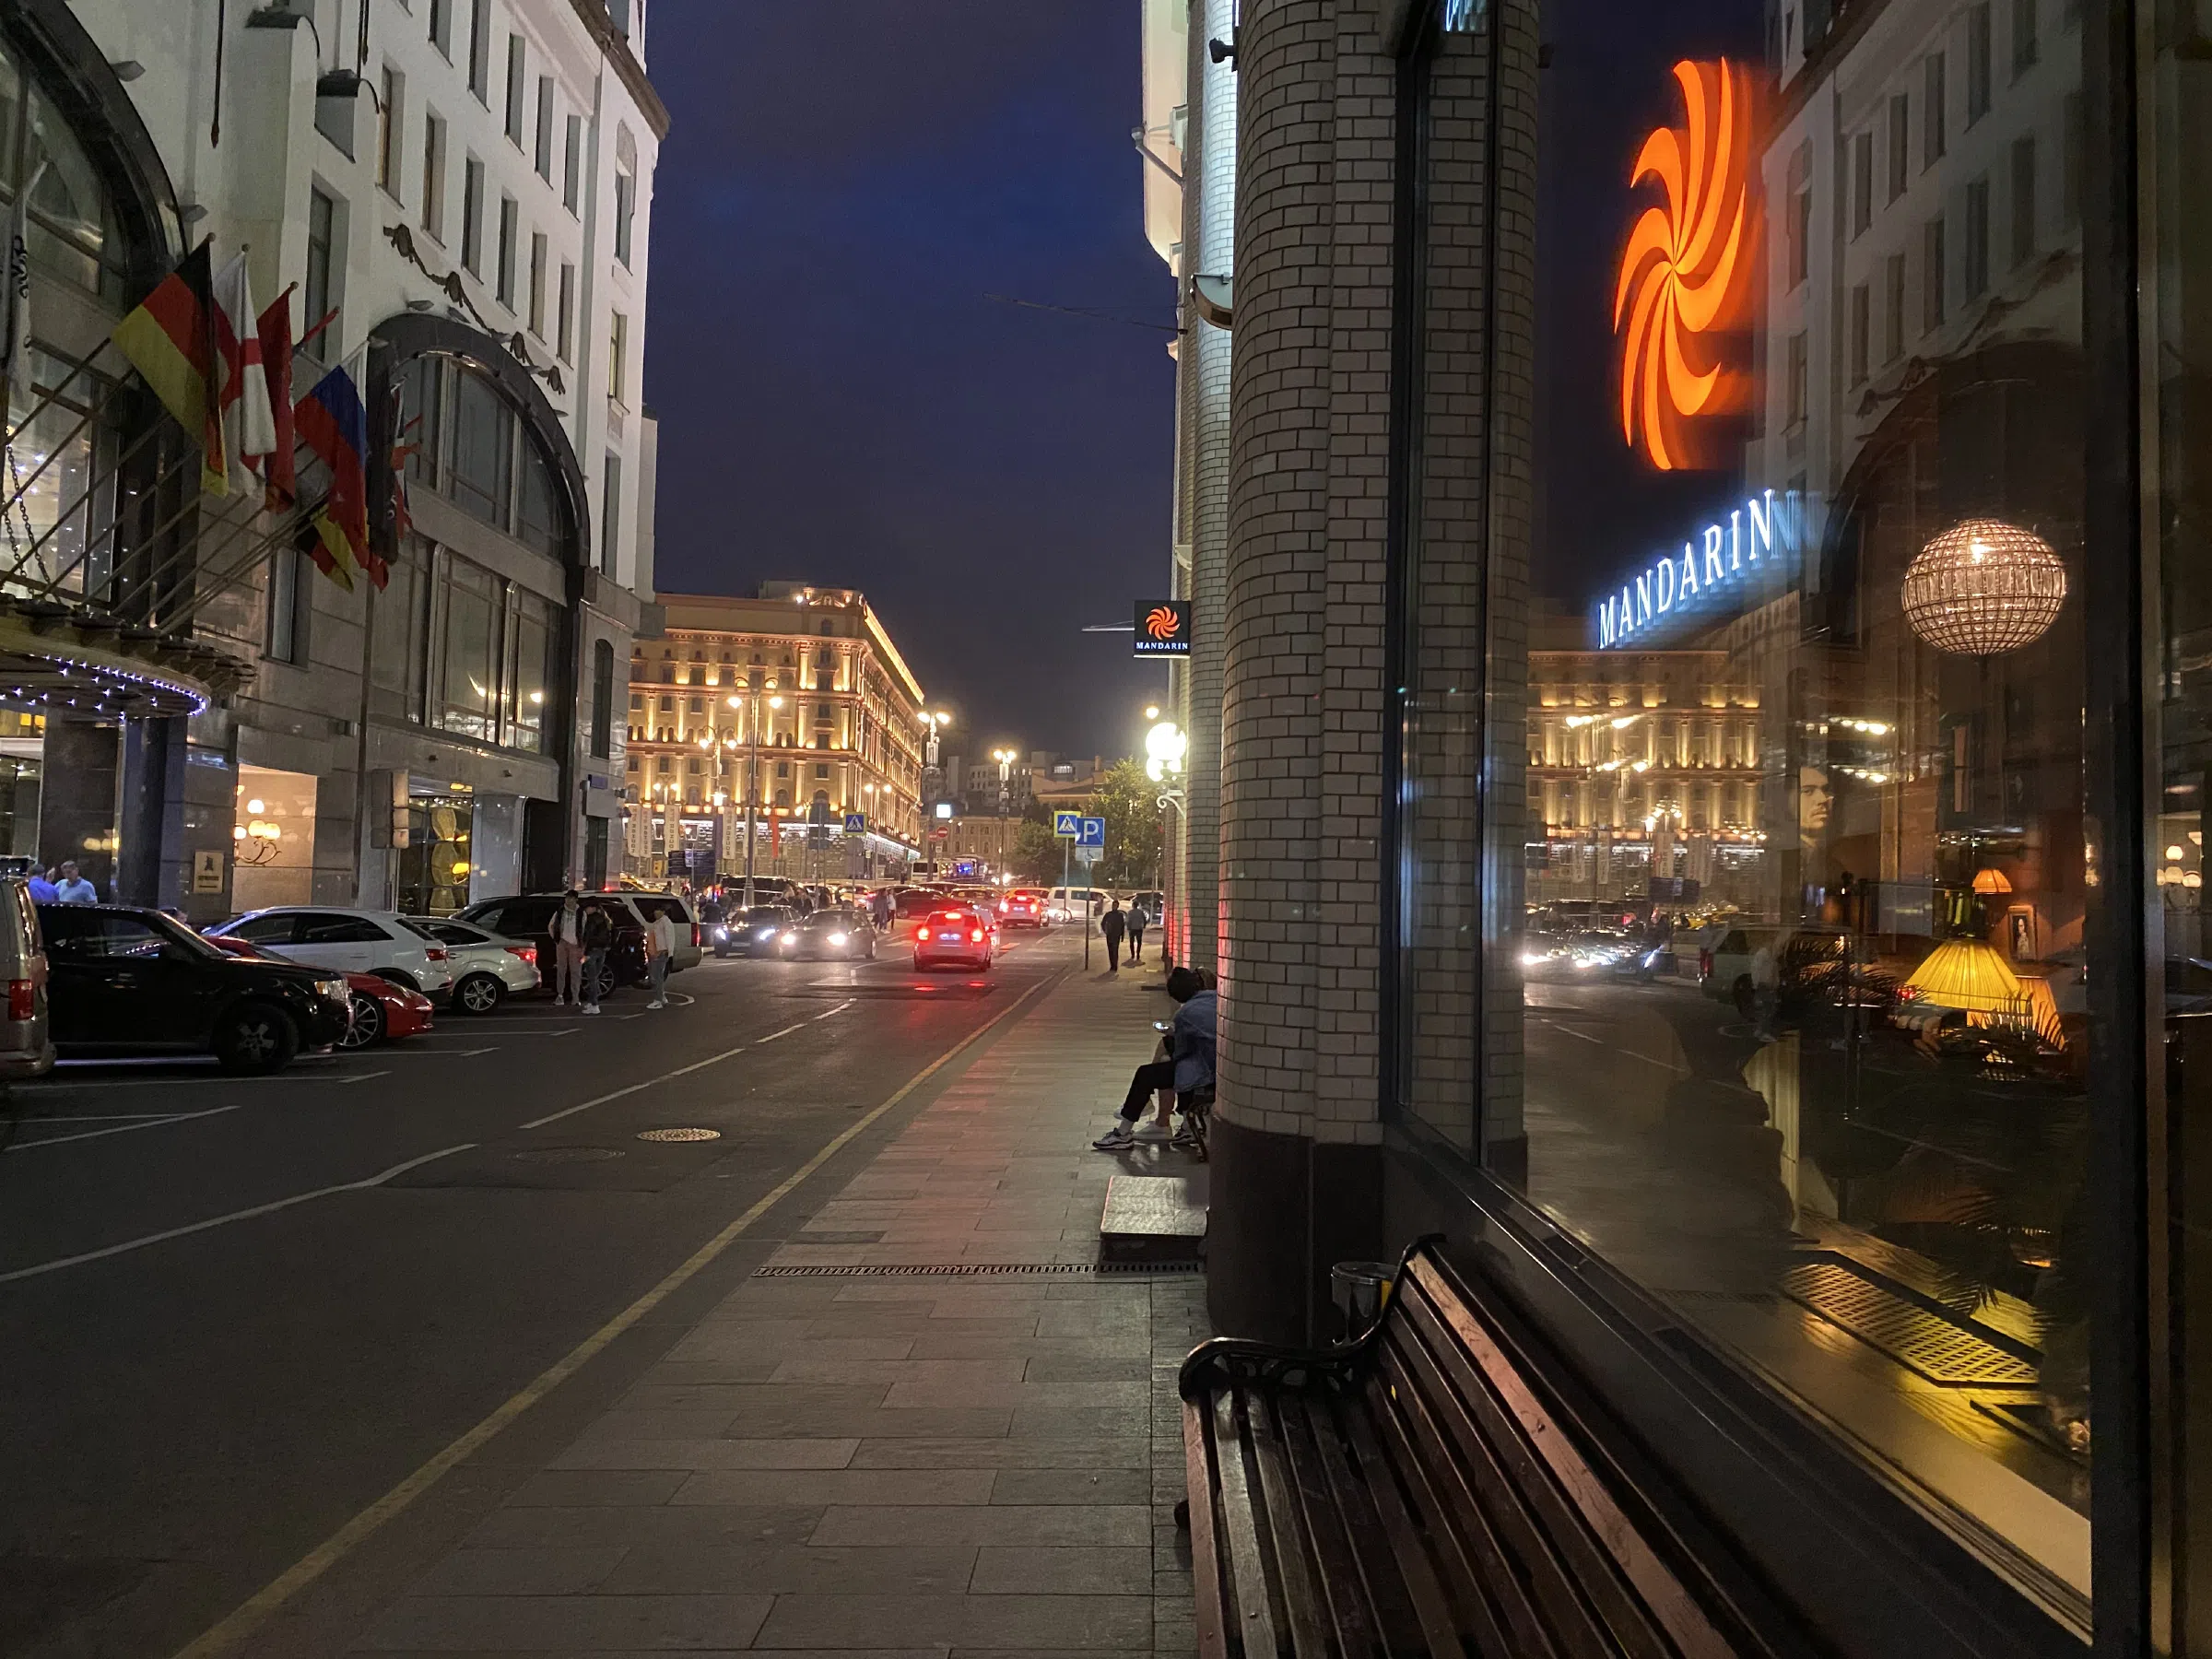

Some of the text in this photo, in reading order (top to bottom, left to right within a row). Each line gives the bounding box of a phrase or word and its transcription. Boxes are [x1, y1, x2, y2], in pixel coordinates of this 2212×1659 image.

[1598, 488, 1773, 650] MANDARIN
[1135, 641, 1188, 650] MANDARIN
[1083, 819, 1100, 843] P
